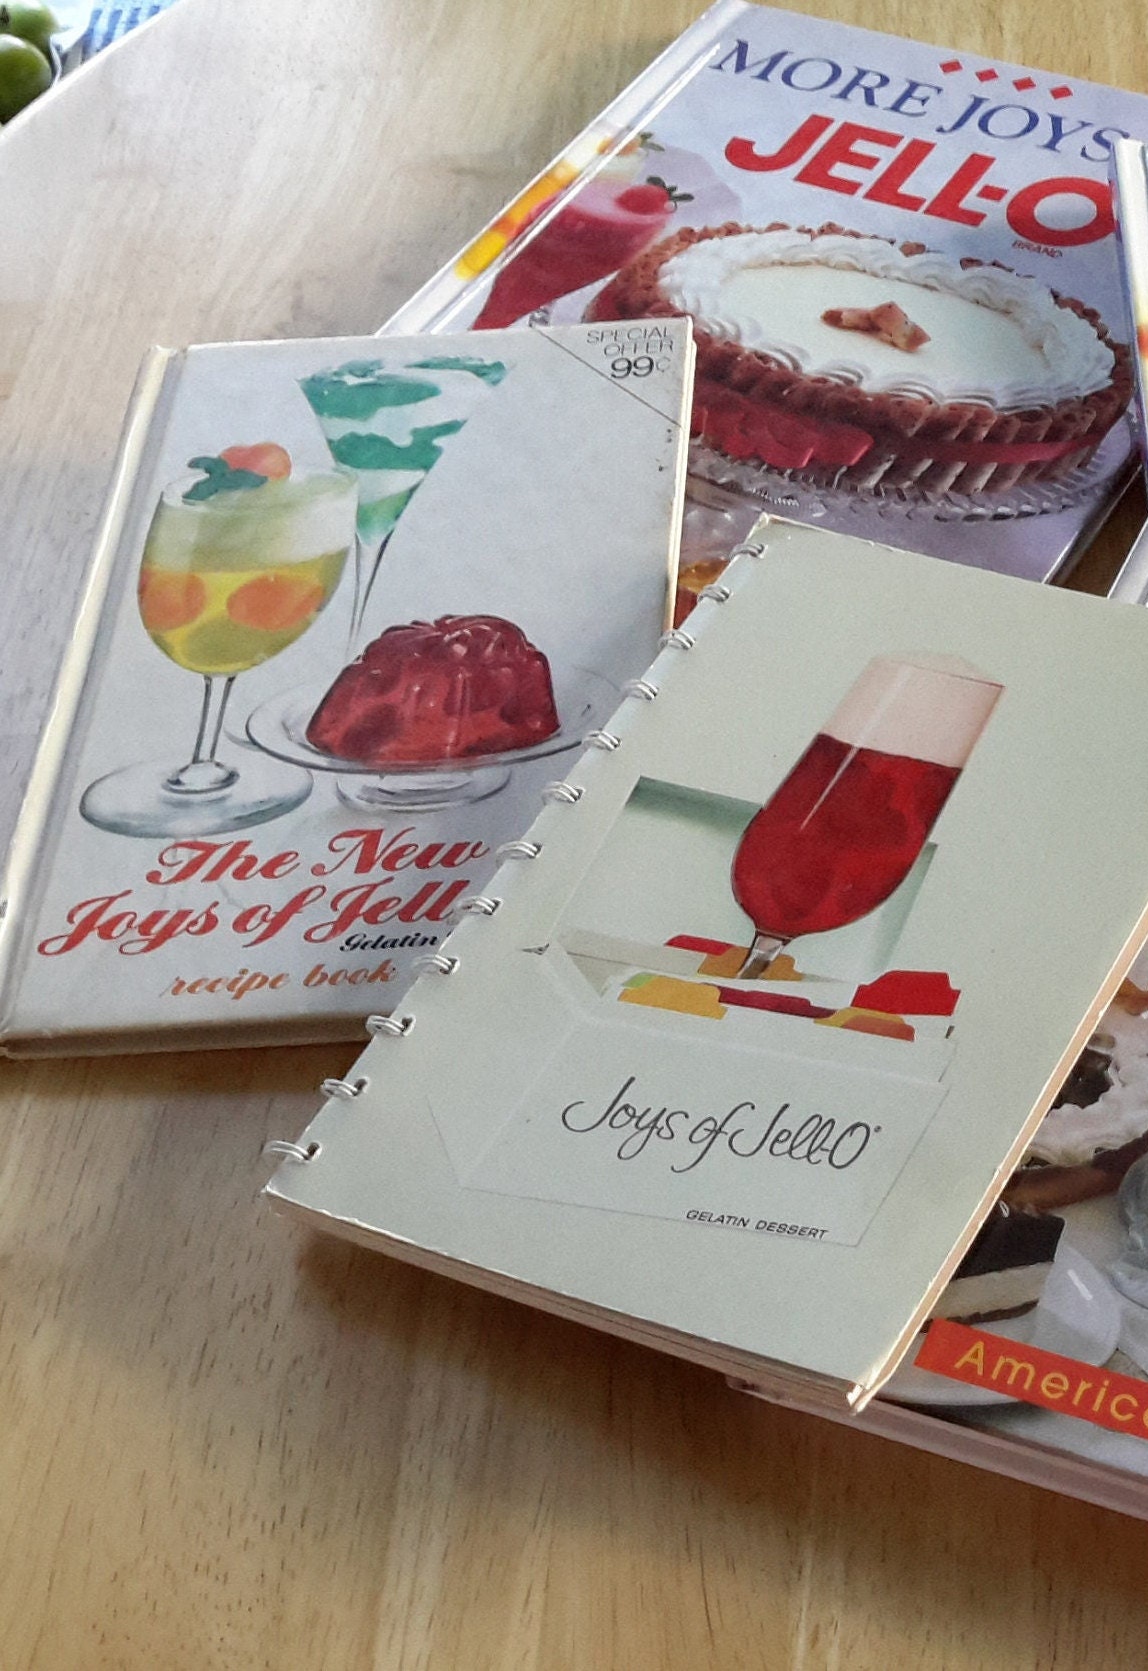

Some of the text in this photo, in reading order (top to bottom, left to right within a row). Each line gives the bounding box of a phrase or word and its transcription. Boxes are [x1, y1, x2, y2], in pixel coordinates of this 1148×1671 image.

[711, 39, 1130, 163] MORE JOYS
[725, 113, 1115, 248] JELL-O
[587, 326, 668, 344] SPECIAL
[604, 340, 674, 357] OFFER
[145, 826, 490, 885] The New
[37, 890, 219, 956] Joys
[231, 884, 327, 949] of
[340, 933, 437, 951] Gelatin
[160, 959, 396, 1000] recipe book
[561, 1076, 689, 1160] Joys
[671, 1101, 756, 1173] of
[686, 1209, 829, 1240] GELATIN DESSERT
